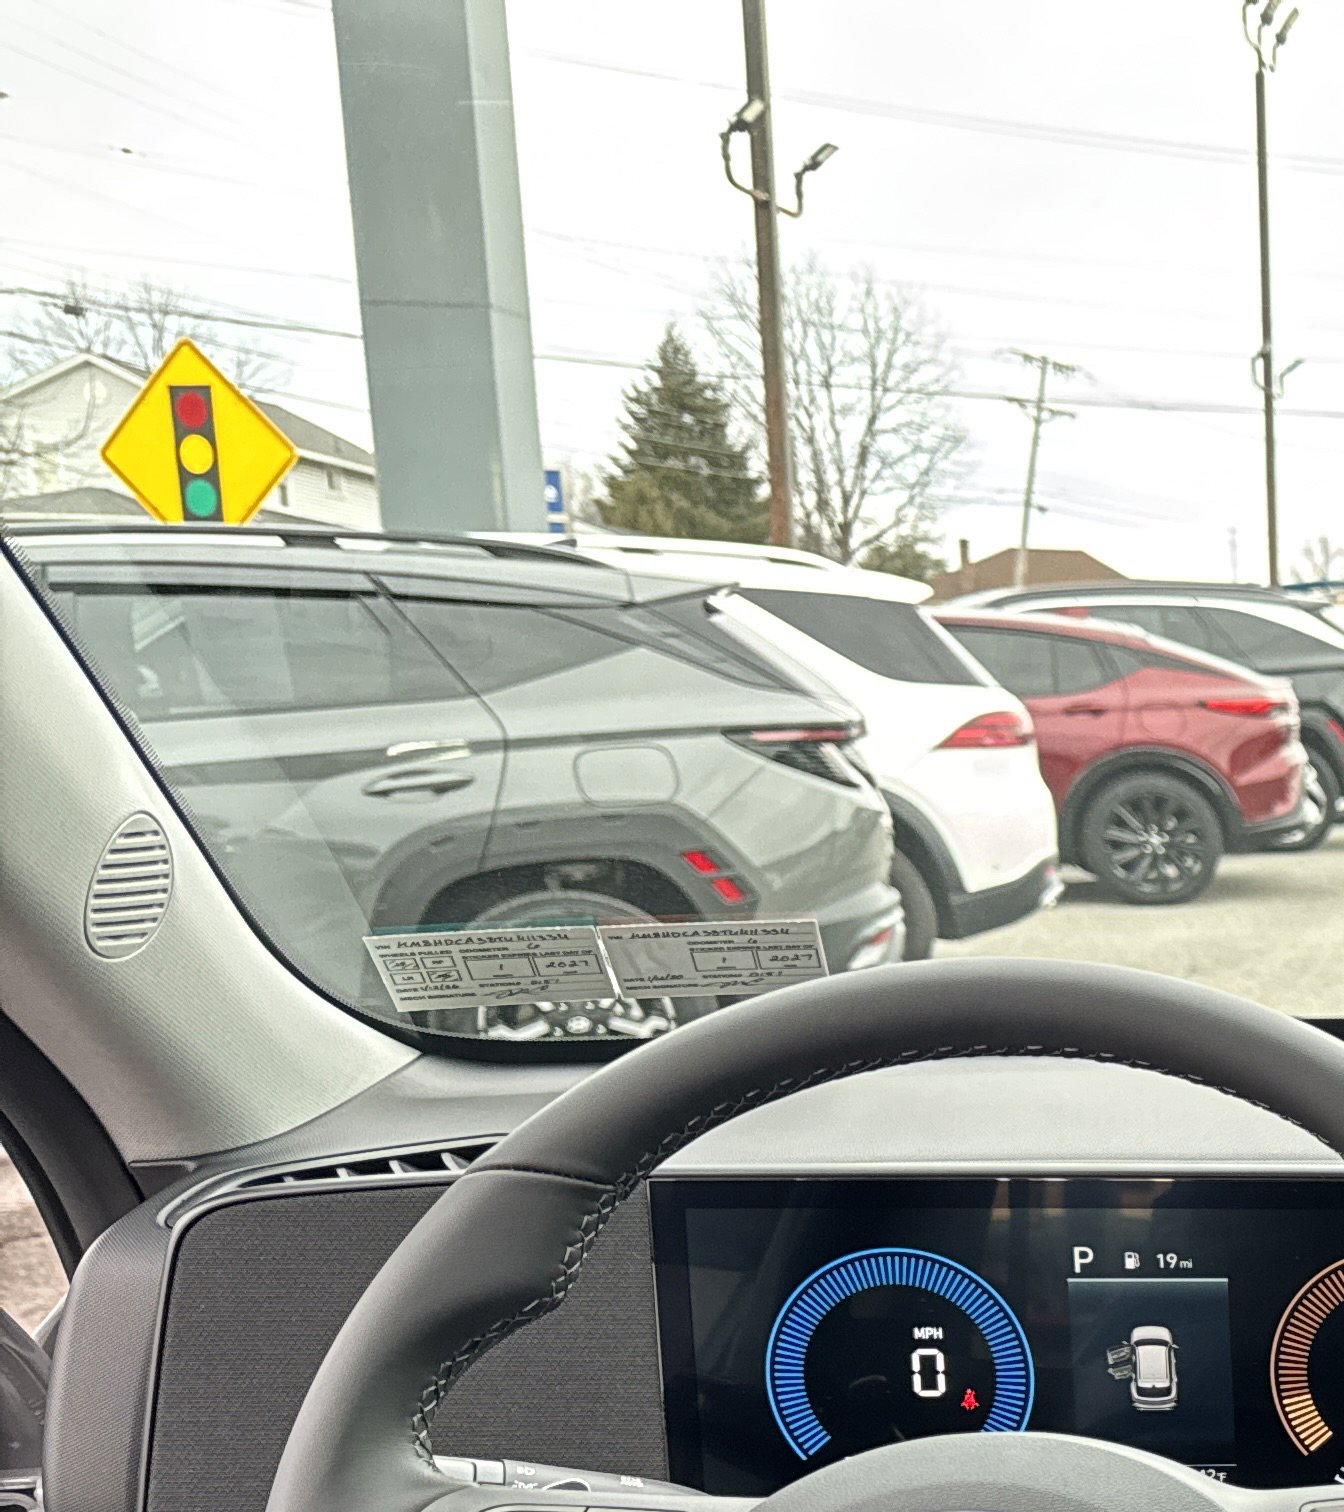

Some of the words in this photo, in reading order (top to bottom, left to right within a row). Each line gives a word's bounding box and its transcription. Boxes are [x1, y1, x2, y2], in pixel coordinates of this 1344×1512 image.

[546, 959, 588, 968] 2027
[1074, 1247, 1093, 1273] P
[1157, 1254, 1177, 1268] 19
[1180, 1259, 1193, 1269] mi
[915, 1328, 942, 1338] MPH
[912, 1349, 946, 1397] 0
